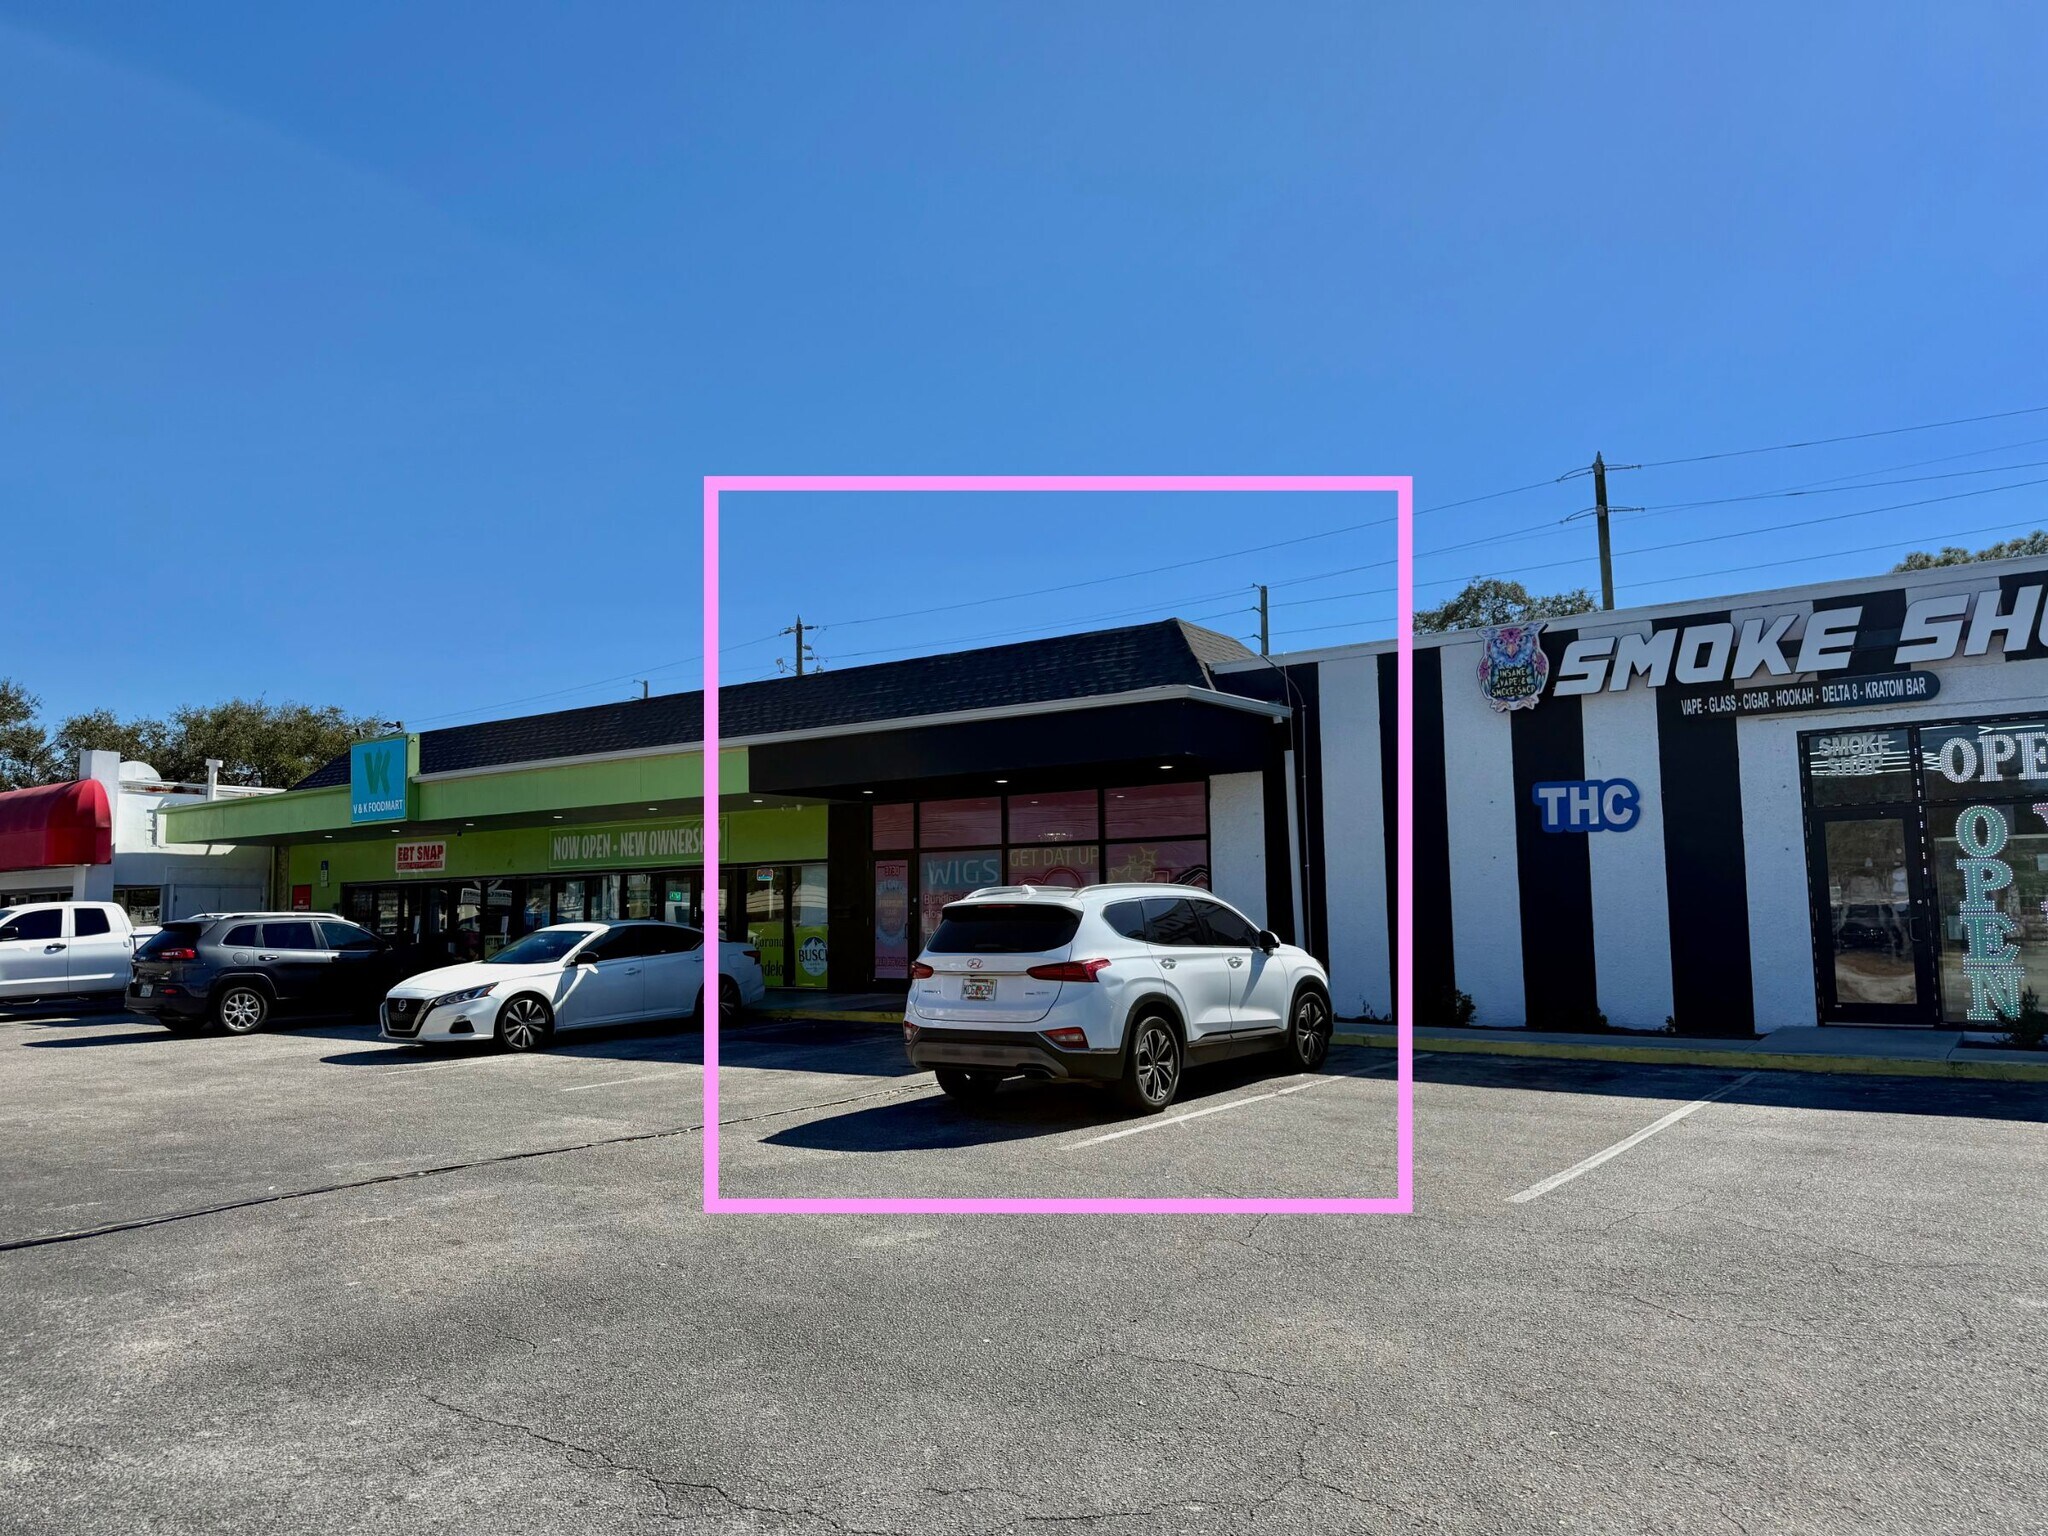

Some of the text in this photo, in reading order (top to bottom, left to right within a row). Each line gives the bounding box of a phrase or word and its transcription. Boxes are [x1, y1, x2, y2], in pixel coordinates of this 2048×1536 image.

[1553, 584, 2048, 697] SMOKE SH
[1500, 668, 1526, 677] INSANE
[1500, 678, 1517, 687] VAPE
[1492, 685, 1536, 697] SMOKE SHOP
[1681, 699, 1703, 716] VAPE
[1709, 696, 1737, 713] GLASS
[1743, 692, 1770, 710] CIGAR
[1776, 687, 1815, 707] HOOKAH
[1822, 683, 1850, 703] DELTA
[1852, 683, 1858, 700] 8
[1865, 679, 1904, 699] KRATOM
[1906, 676, 1927, 695] BAR
[1818, 734, 1890, 757] SMOKE
[1827, 756, 1884, 776] SHOP
[368, 799, 404, 812] FOODMART
[1538, 784, 1635, 827] THC
[397, 844, 444, 862] EBT SNAP
[553, 835, 580, 861] NOW
[582, 833, 611, 859] OPEN
[620, 831, 648, 857] NEW
[650, 825, 721, 855] OWNERS
[1009, 847, 1099, 867] GET DAT UP
[927, 860, 999, 885] WIGS
[1955, 805, 2025, 1021] OPEN
[798, 949, 828, 963] BUSC
